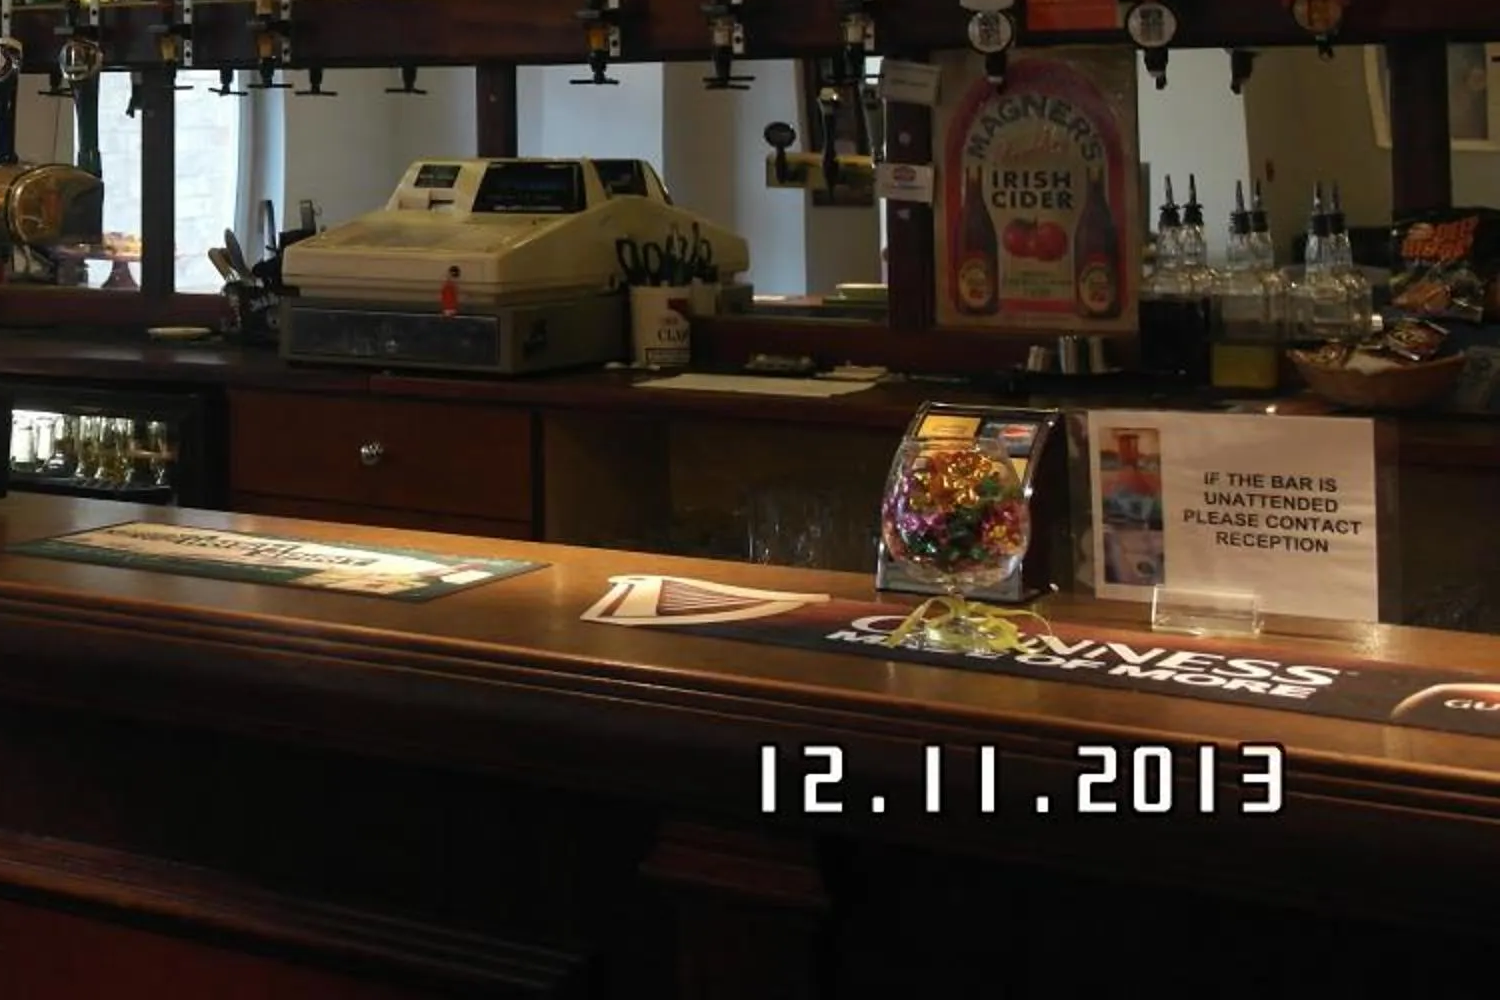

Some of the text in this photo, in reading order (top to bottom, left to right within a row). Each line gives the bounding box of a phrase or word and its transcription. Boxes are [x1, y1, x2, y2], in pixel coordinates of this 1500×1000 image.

[992, 171, 1071, 189] IRISH
[991, 191, 1074, 209] CIDER
[1204, 472, 1338, 493] IF THE BAR IS
[1204, 492, 1339, 513] UNATTENDED
[1183, 509, 1363, 535] PLEASE CONTACT
[1216, 531, 1329, 553] RECEPTION
[1108, 664, 1316, 700] MORE
